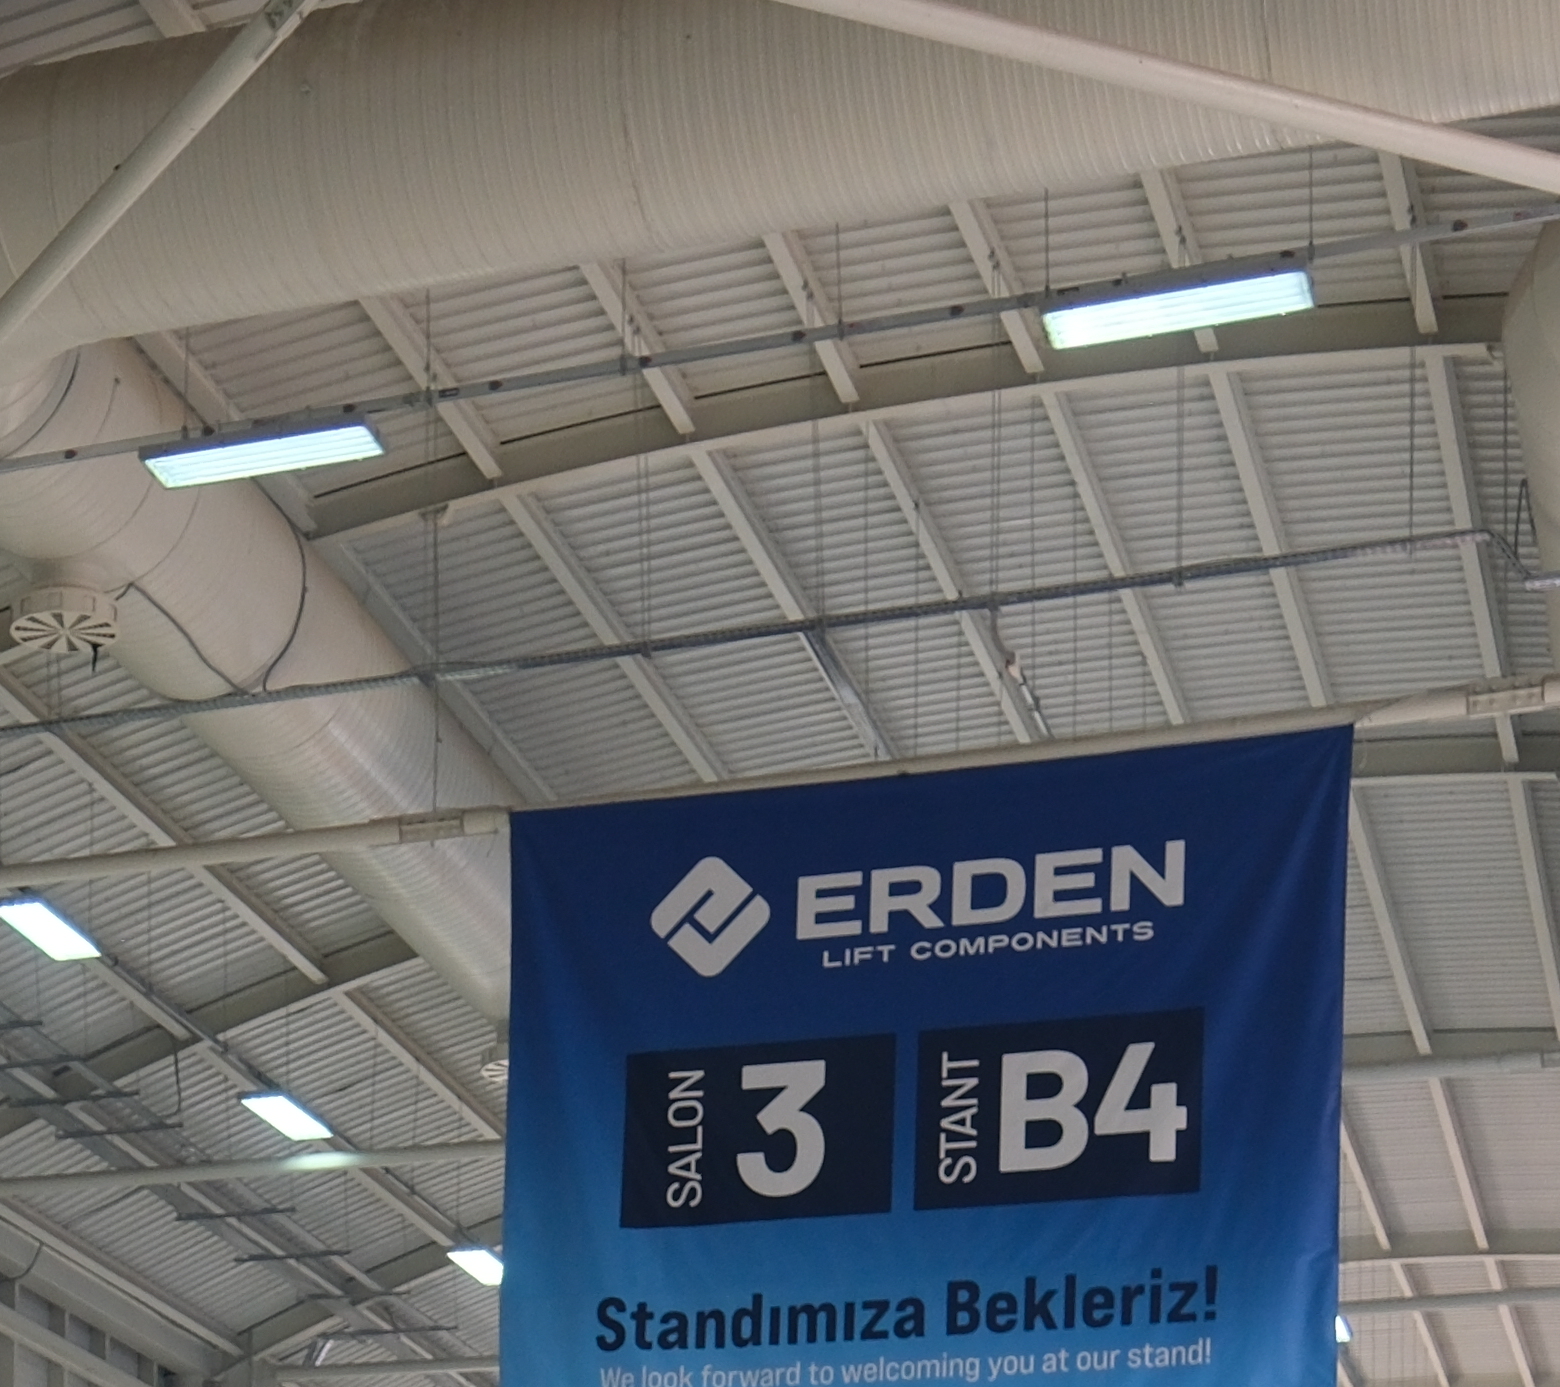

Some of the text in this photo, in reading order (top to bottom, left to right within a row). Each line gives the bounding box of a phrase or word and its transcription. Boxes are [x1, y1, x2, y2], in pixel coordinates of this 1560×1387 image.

[795, 839, 1186, 941] ERDEN
[822, 921, 1155, 969] LIFT COMPONENTS
[666, 1059, 827, 1208] SALON 3
[940, 1041, 1188, 1185] STANT B4
[596, 1265, 1219, 1352] Standımıza Bekleriz!
[809, 1361, 835, 1386] to
[842, 1352, 980, 1383] welcoming
[987, 1355, 1034, 1382] you
[1042, 1348, 1069, 1374] at
[1076, 1349, 1120, 1372] our
[1127, 1337, 1212, 1370] stand!
